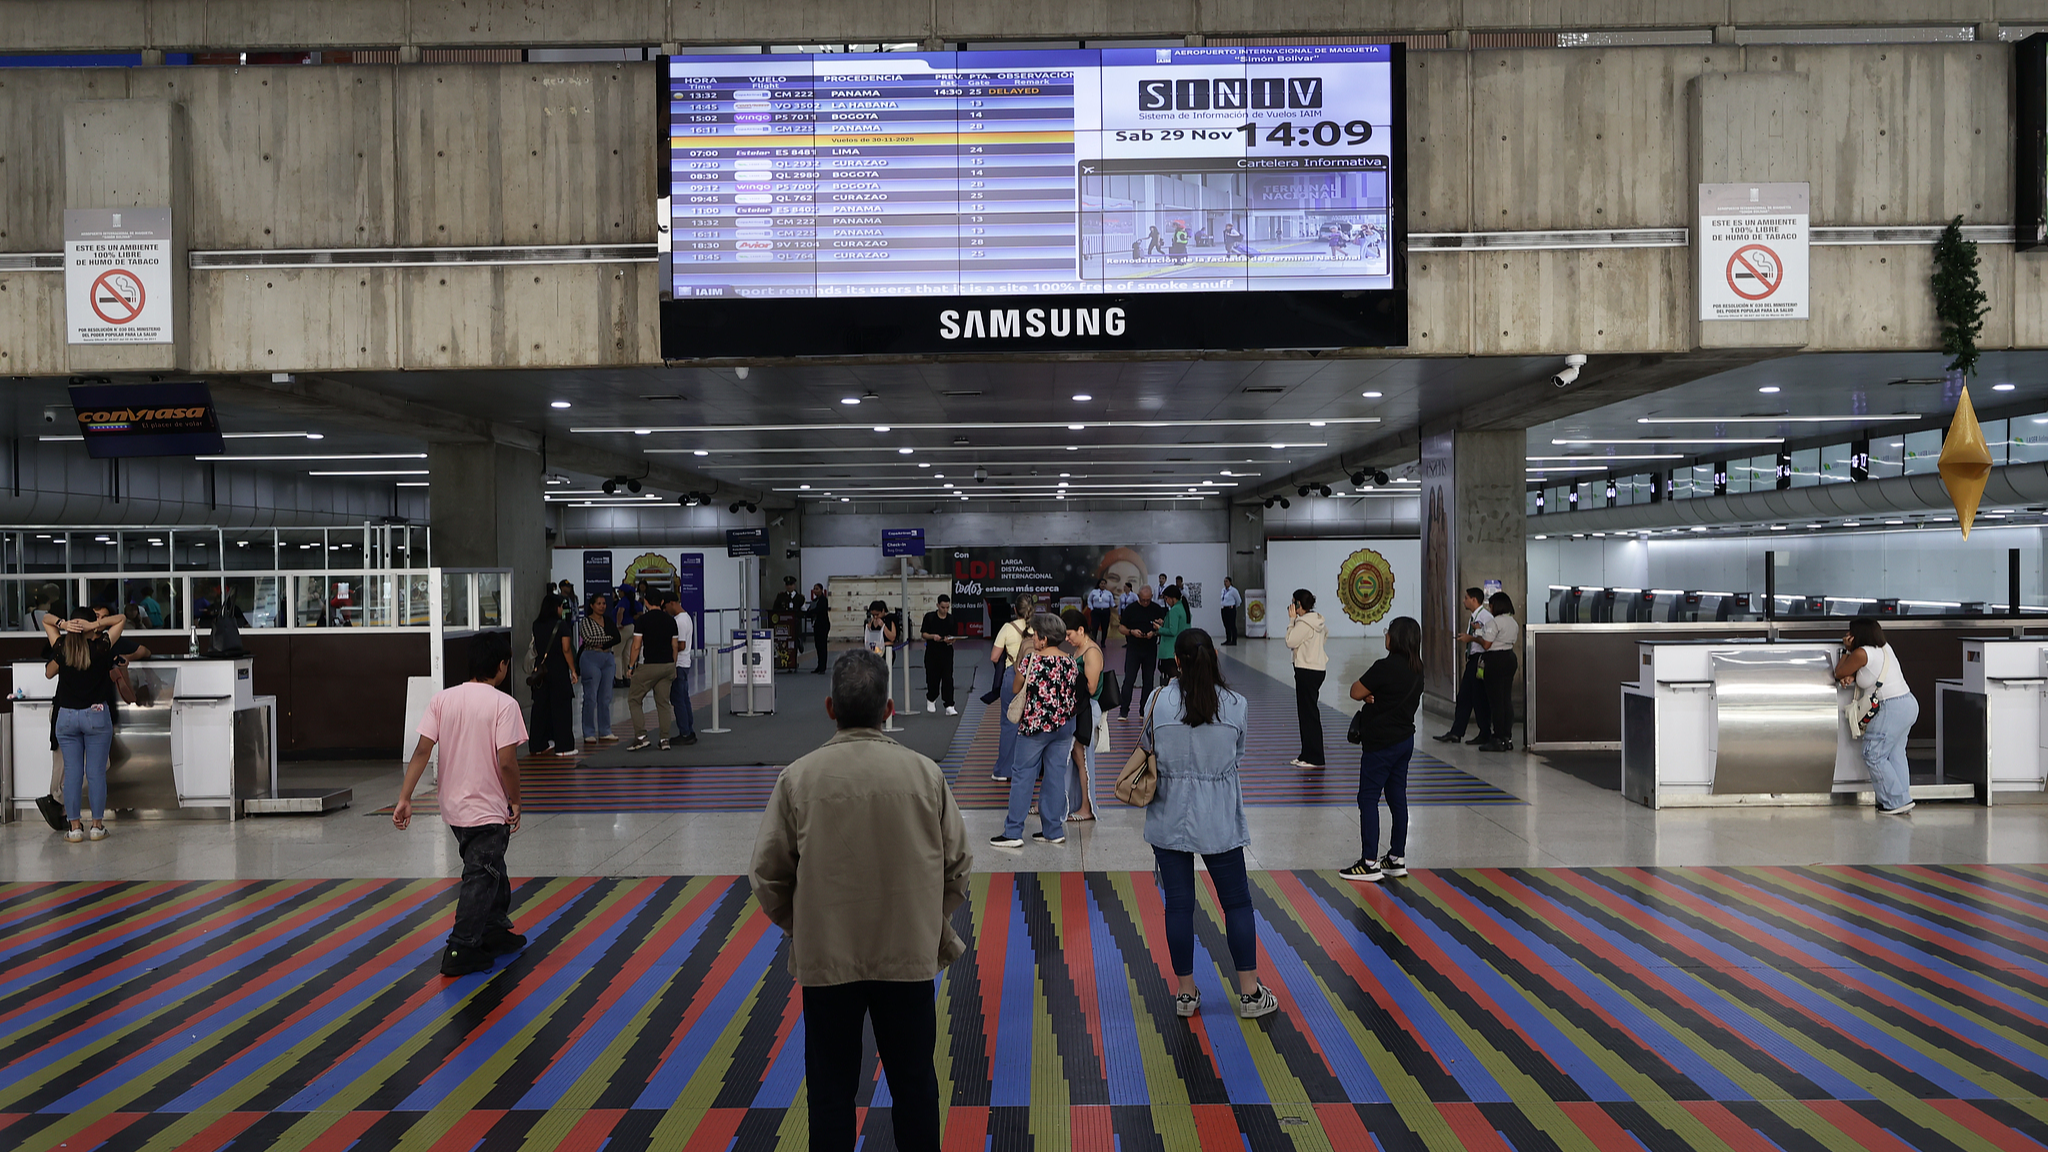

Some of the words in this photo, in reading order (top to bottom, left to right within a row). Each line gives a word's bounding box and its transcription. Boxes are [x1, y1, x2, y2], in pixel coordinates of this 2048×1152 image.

[1330, 46, 1379, 54] MAIQUETÍA
[824, 74, 903, 83] PROCEDENCIA
[752, 82, 780, 90] Flight
[1014, 78, 1050, 86] Remark
[690, 92, 718, 100] 13:32
[831, 90, 881, 98] PANAMA
[1142, 79, 1320, 110] SINIV
[831, 101, 846, 109] LA
[849, 101, 898, 109] HABANA
[736, 114, 770, 122] wingo
[831, 113, 879, 121] BOGOTA
[1139, 112, 1172, 121] Sistema
[1178, 112, 1190, 120] de
[1193, 111, 1249, 120] Información
[1252, 110, 1264, 119] de
[1267, 110, 1297, 119] Vuelos
[1300, 110, 1322, 118] IAIM
[832, 124, 882, 132] PANAMA
[1116, 130, 1154, 142] Sab
[1160, 130, 1185, 142] 29
[1192, 130, 1233, 141] Nov
[1236, 120, 1373, 147] 14:09
[832, 148, 860, 156] LIMA
[1237, 158, 1299, 168] Cartelera
[1304, 157, 1382, 167] Informativa
[1264, 184, 1338, 193] TERMINAL
[1263, 192, 1338, 200] NACIONAL
[833, 217, 882, 225] PANAMA
[1730, 226, 1753, 234] 100%
[76, 244, 94, 252] ESTE
[692, 242, 720, 250] 18:30
[1106, 256, 1178, 265] Remodelación
[1207, 255, 1248, 263] fachada
[1269, 254, 1313, 262] Terminal
[696, 288, 723, 296] IAIM
[780, 285, 842, 296] reminds
[846, 285, 866, 295] its
[870, 286, 912, 294] users
[915, 284, 949, 293] that
[954, 284, 966, 293] it
[970, 283, 982, 293] is
[1000, 283, 1028, 292] site
[1033, 282, 1075, 292] 100%
[1079, 282, 1113, 291] free
[1116, 281, 1134, 291] of
[1138, 280, 1188, 291] smoke
[1192, 280, 1234, 290] snuff
[940, 308, 1125, 338] SAMSUNG
[78, 407, 206, 423] conviasa
[955, 560, 996, 579] LDI
[955, 580, 984, 596] todos
[1016, 584, 1034, 592] más
